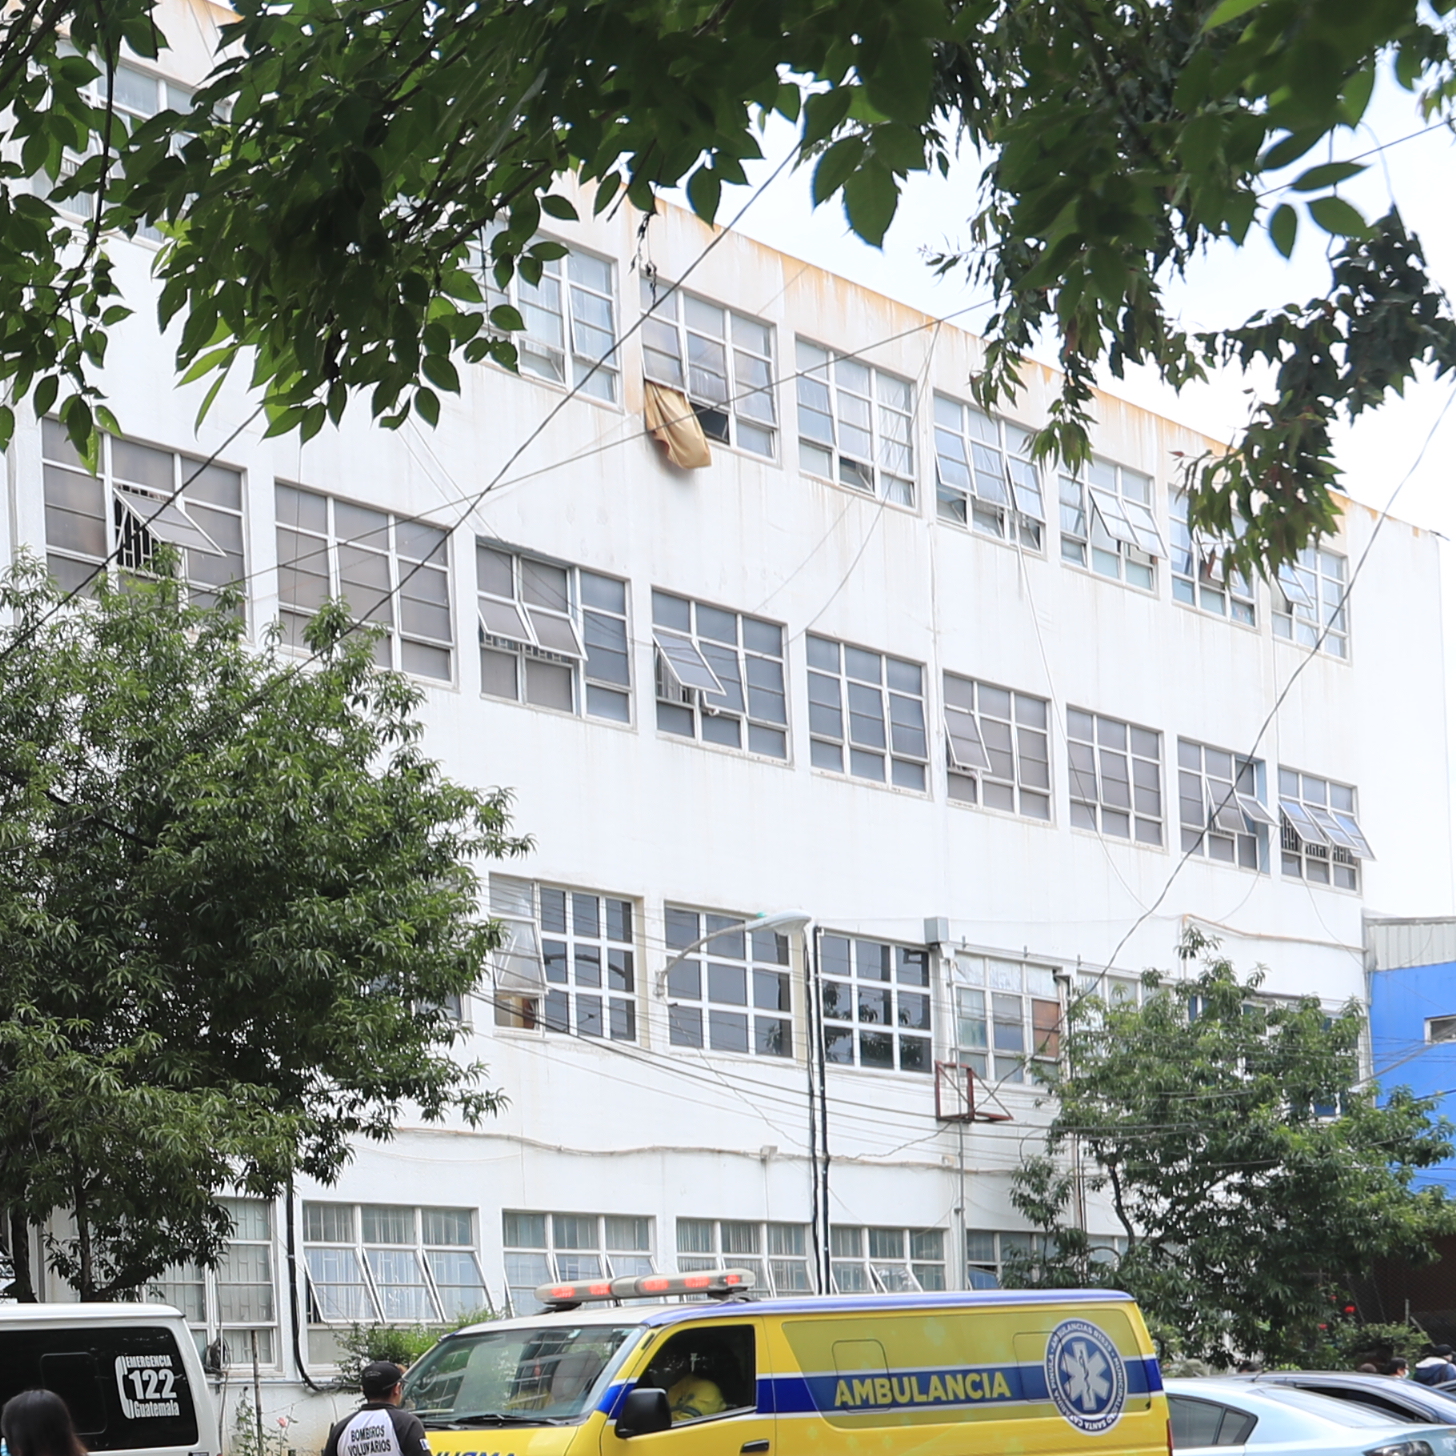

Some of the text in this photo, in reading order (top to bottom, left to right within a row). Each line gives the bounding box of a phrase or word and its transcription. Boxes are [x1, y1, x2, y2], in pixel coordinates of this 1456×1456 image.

[125, 1355, 173, 1368] EMERGENCIA
[128, 1368, 177, 1399] 122
[834, 1371, 1012, 1407] AMBULANCIA
[134, 1399, 180, 1418] Guatemala
